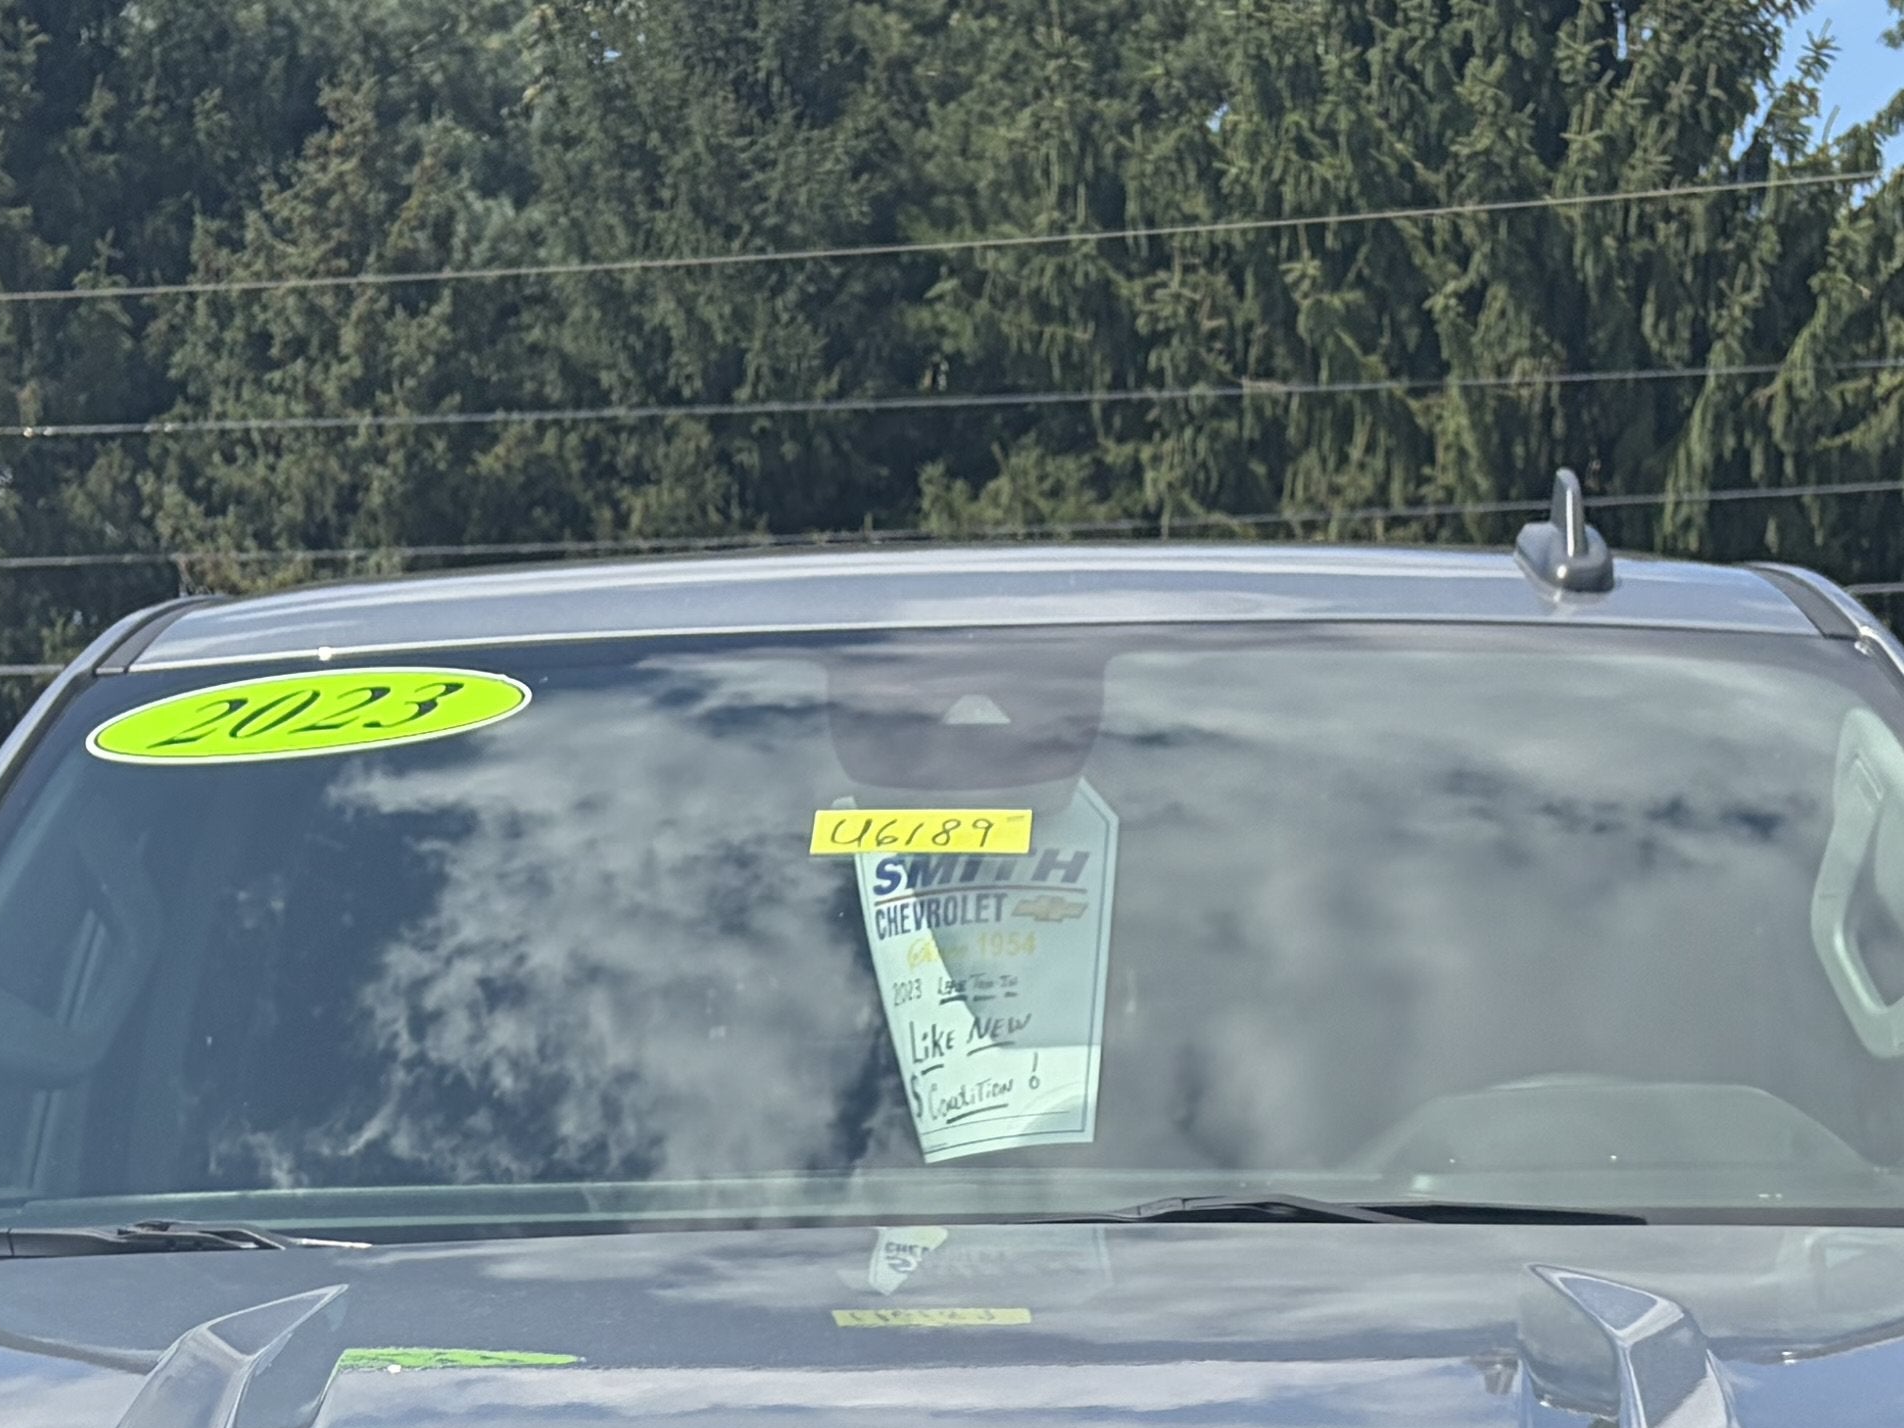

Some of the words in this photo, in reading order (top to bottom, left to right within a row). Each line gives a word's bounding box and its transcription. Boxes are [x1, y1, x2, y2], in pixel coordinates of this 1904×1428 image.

[146, 682, 465, 749] 2023
[873, 849, 1090, 896] SMITH
[875, 893, 1008, 941] CHEVROLET
